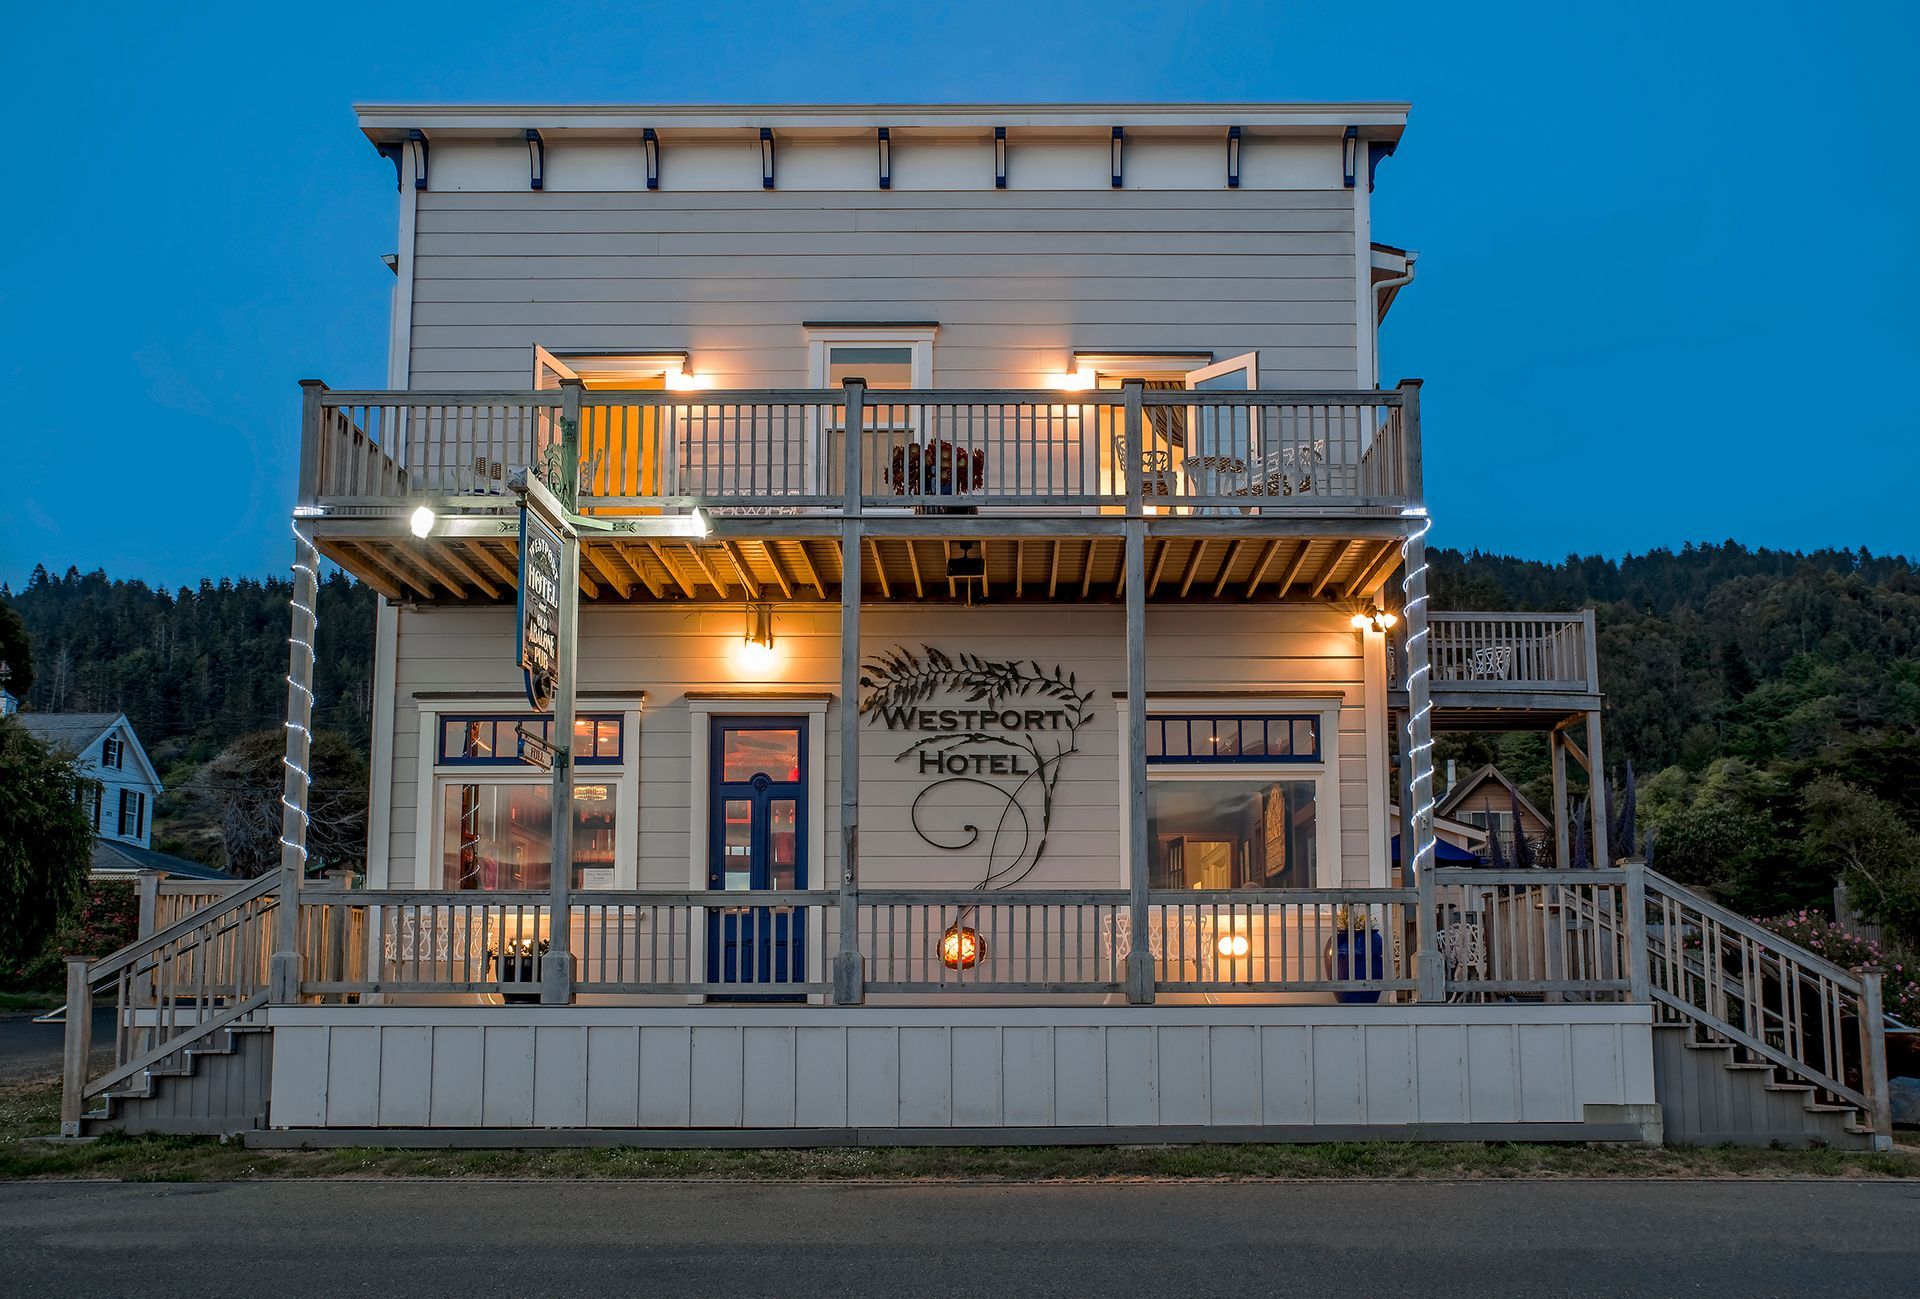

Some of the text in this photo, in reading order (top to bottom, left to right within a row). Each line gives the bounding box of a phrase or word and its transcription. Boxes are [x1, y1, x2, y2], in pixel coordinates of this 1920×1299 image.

[528, 537, 559, 581] WESTPORT
[528, 562, 558, 609] HOTEL
[536, 613, 548, 632] OLD
[528, 619, 556, 659] ABALONE
[534, 646, 549, 671] PUB
[882, 706, 1065, 731] WESTPORT
[919, 750, 1029, 775] HOTEL
